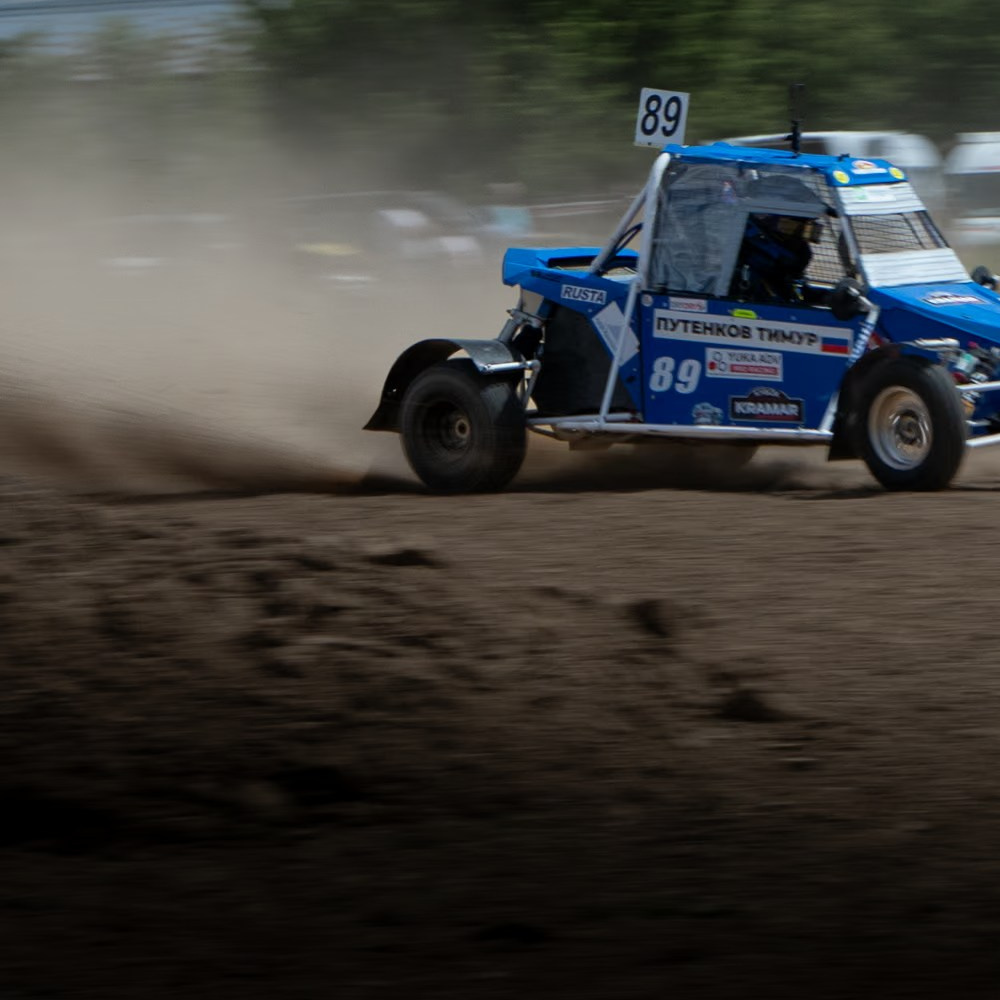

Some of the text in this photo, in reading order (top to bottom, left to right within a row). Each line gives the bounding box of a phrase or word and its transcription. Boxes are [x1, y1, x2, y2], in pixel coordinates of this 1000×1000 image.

[641, 94, 682, 137] 89
[563, 286, 605, 302] RUSTA
[656, 316, 819, 347] ПУТЕНКОВ ТИМУР
[649, 356, 702, 394] 89
